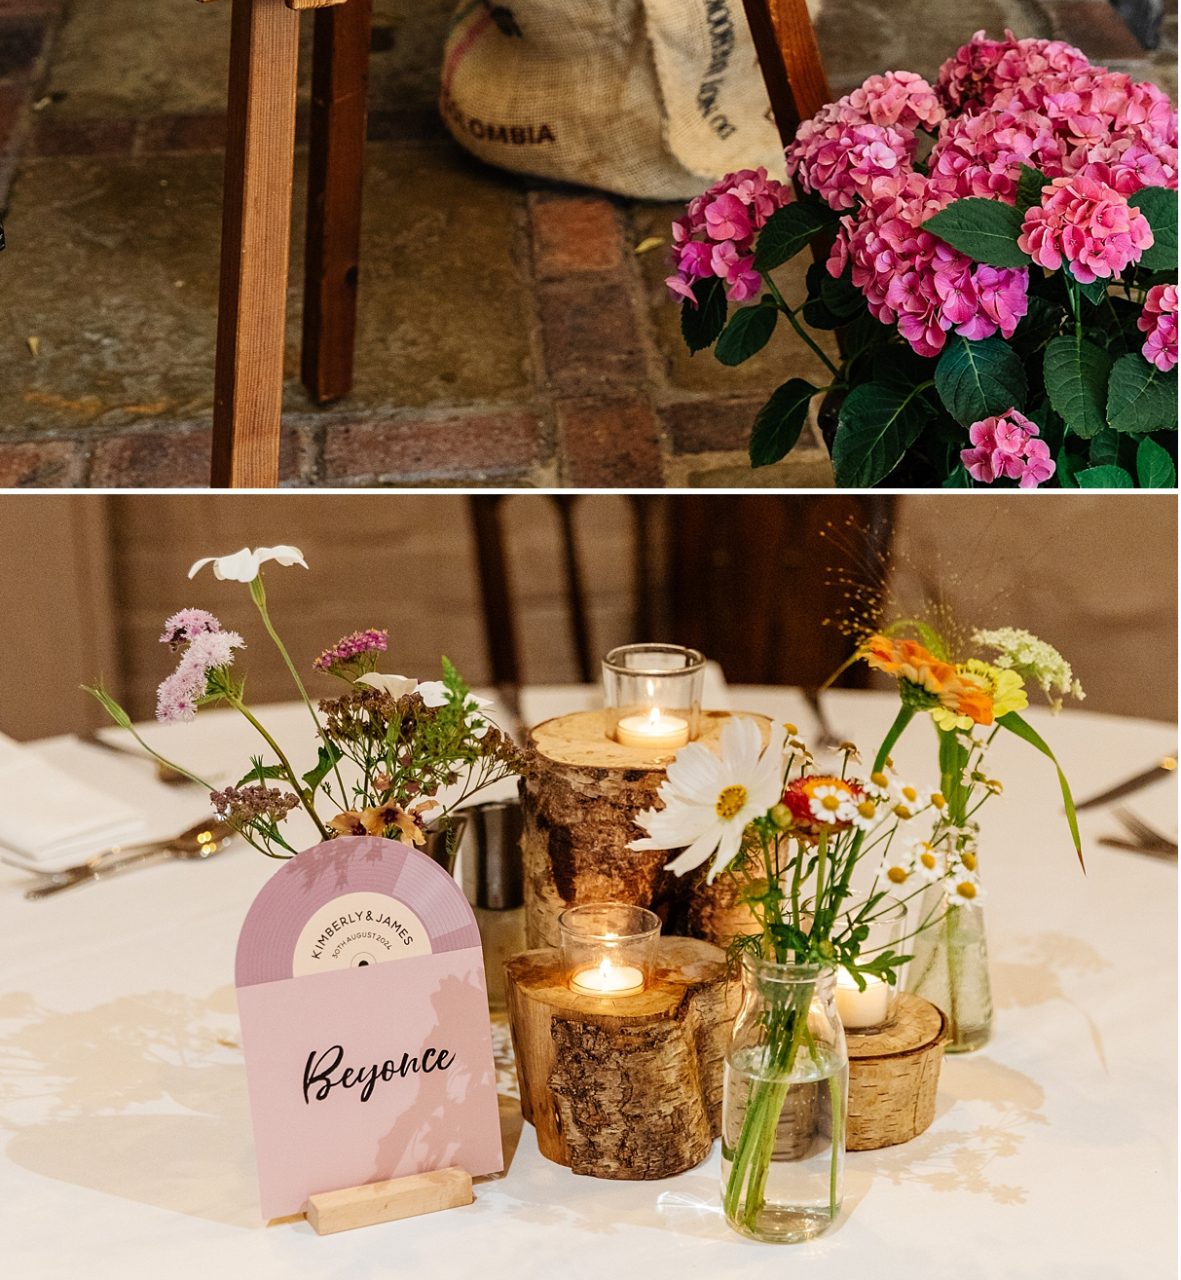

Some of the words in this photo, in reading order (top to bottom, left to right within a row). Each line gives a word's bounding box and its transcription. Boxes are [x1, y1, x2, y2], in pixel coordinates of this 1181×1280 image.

[311, 910, 364, 961] KIMBERLY
[364, 909, 374, 922] &
[375, 913, 414, 947] JAMES
[345, 931, 377, 943] AUGUST
[302, 1044, 457, 1105] Beyonce
